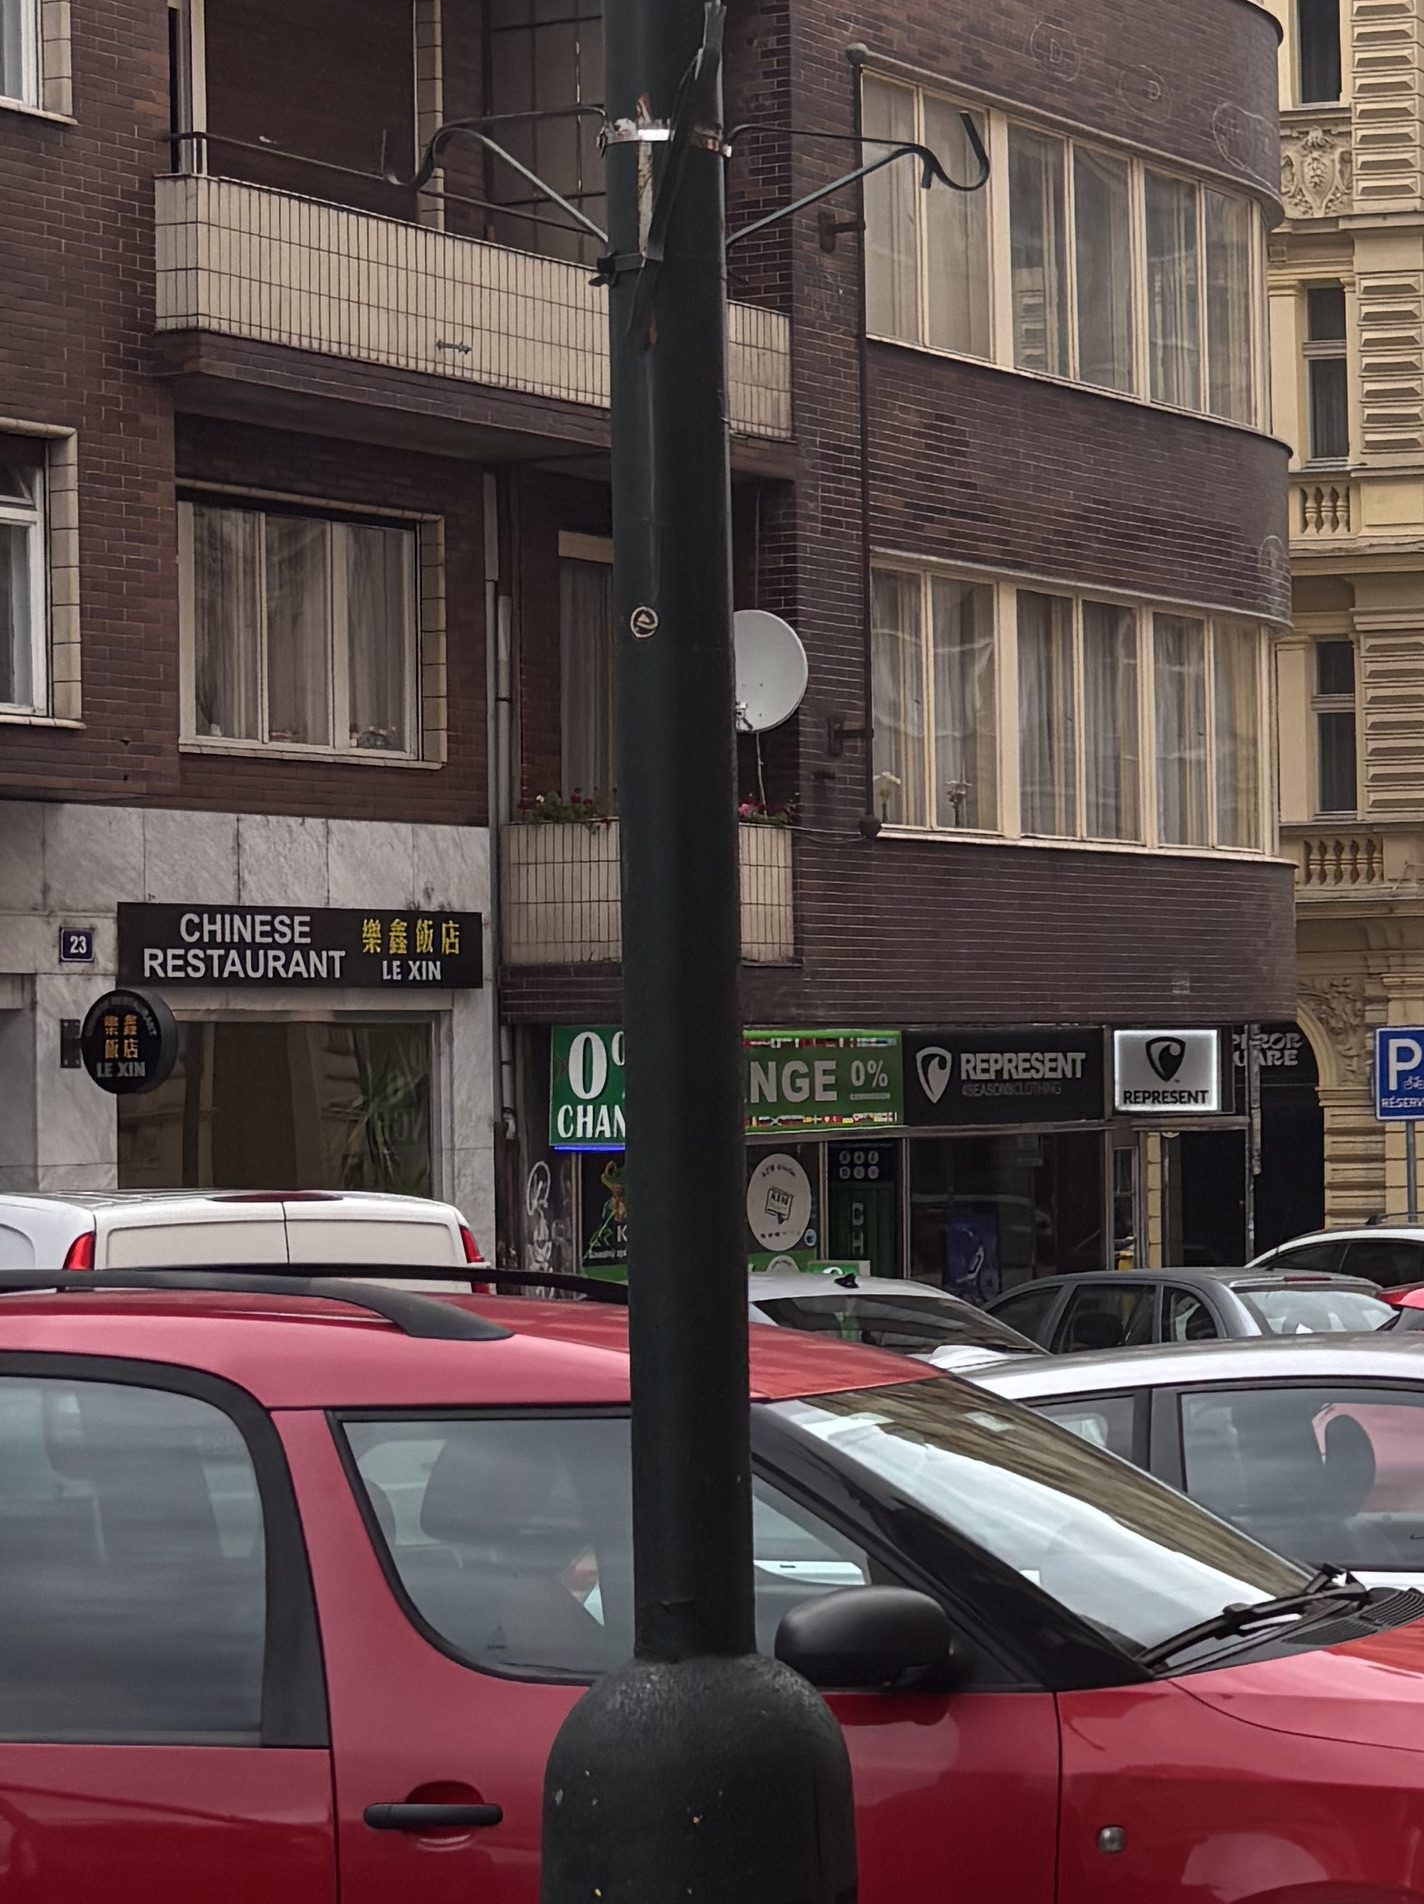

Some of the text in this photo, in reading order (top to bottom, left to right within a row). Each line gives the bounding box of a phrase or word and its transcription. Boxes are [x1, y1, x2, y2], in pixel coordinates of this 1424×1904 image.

[179, 913, 312, 945] CHINESE
[69, 935, 88, 955] 23
[142, 948, 346, 980] RESTAURANT
[382, 960, 442, 982] LE XIN
[117, 1062, 146, 1077] XIN
[960, 1052, 1087, 1081] REPRESENT
[1388, 1038, 1423, 1091] P
[746, 1059, 889, 1104] NGE 0%
[1123, 1090, 1209, 1105] REPRESENT
[557, 1104, 625, 1139] CHAN
